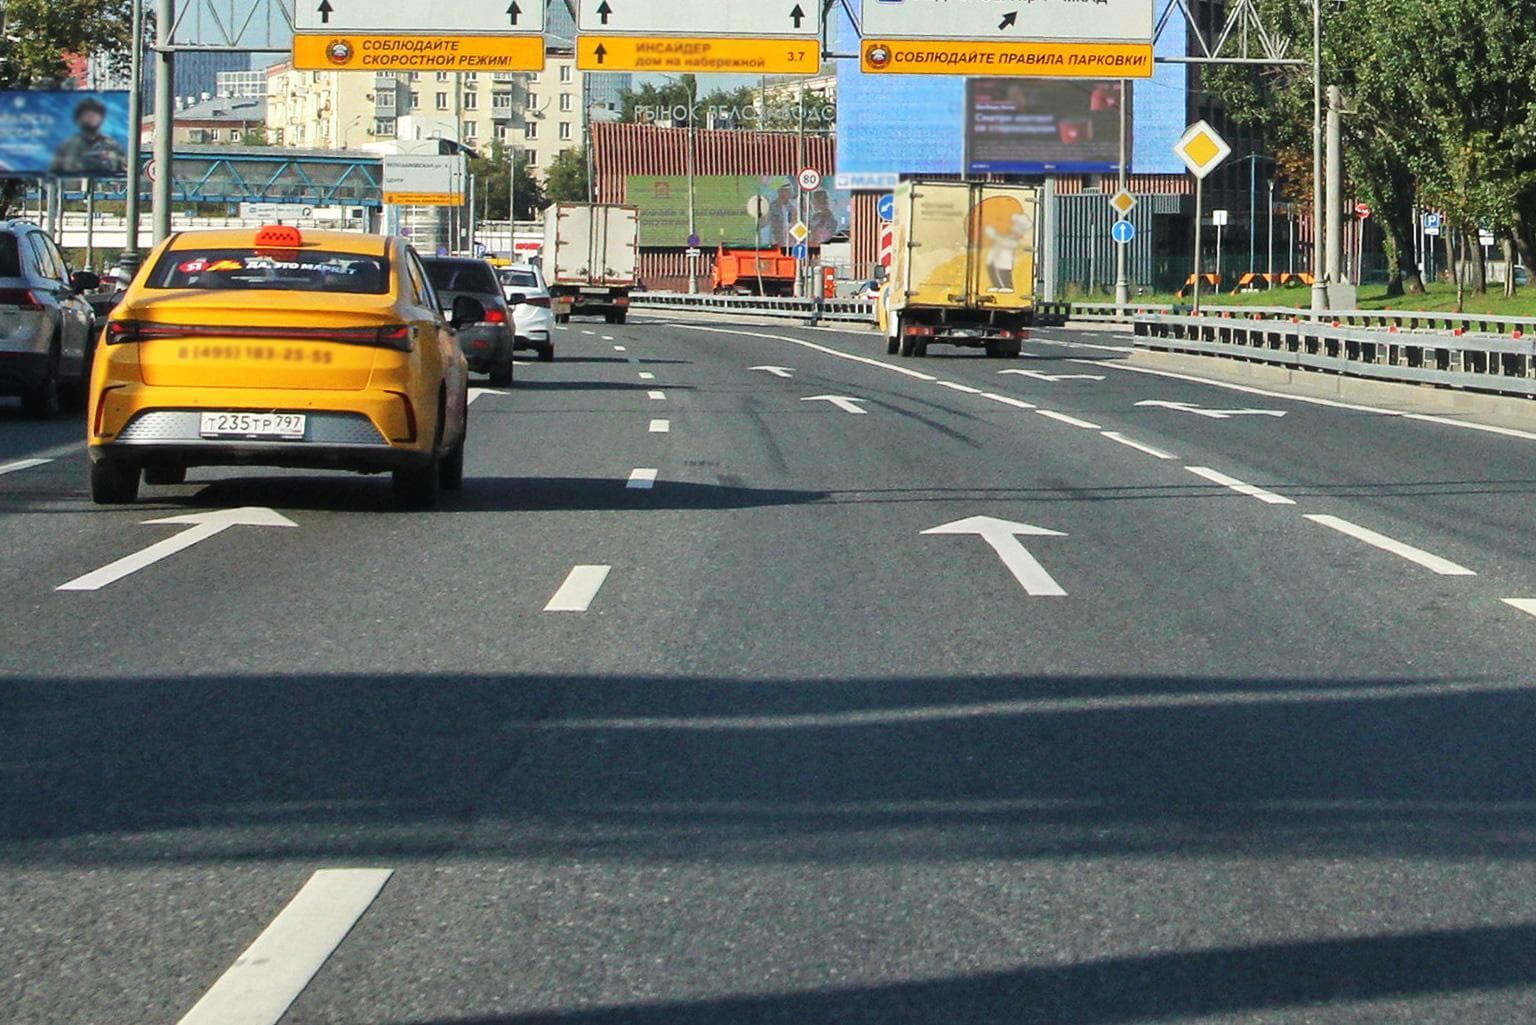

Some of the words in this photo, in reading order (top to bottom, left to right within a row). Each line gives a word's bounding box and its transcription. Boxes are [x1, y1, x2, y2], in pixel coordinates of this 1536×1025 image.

[362, 38, 460, 52] СОБЛЮДАЙТЕ
[635, 42, 711, 56] ИНСАЙДЕР
[362, 52, 457, 66] СКОРОСТНОЙ
[458, 54, 512, 67] РЕЖИМ!
[635, 57, 663, 67] дом
[666, 58, 681, 67] на
[684, 56, 765, 69] набережной
[787, 51, 806, 62] 3.7
[895, 49, 995, 65] СОБЛЮДАЙТЕ
[999, 52, 1064, 66] ПРАВИЛА
[1068, 53, 1147, 67] ПАРКОВКИ!
[634, 104, 699, 123] РЫНОК
[802, 174, 817, 185] 80
[272, 262, 299, 270] ЭТО
[208, 415, 272, 431] Т235ТР
[276, 416, 301, 428] 797
